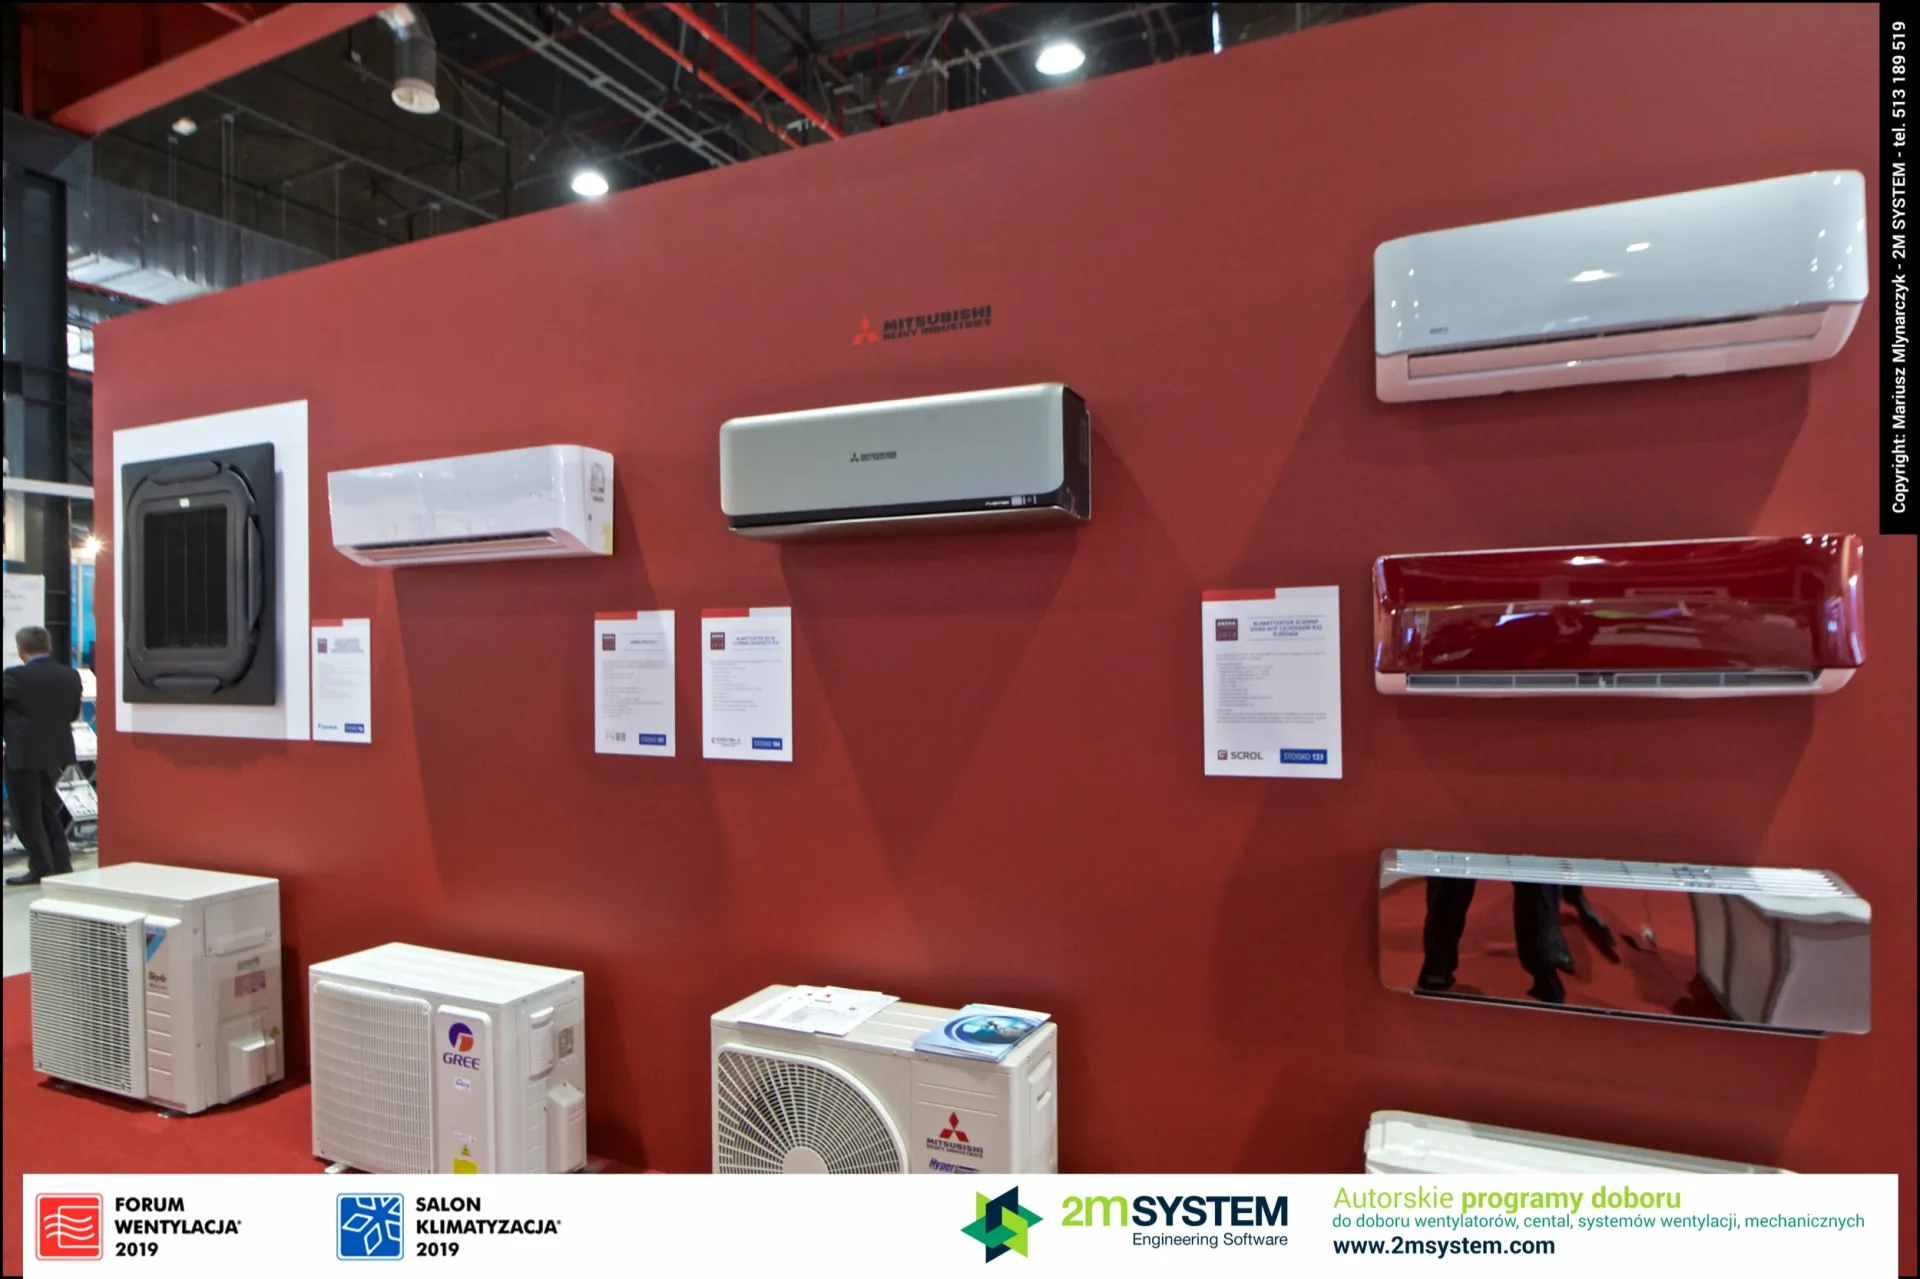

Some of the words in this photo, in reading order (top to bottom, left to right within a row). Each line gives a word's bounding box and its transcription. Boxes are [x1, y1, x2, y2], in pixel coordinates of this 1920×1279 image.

[883, 304, 992, 331] MITSUBISHI
[883, 330, 917, 340] HEAVY
[921, 318, 992, 336] INDUSTRIES
[1230, 751, 1263, 760] SCROL
[1283, 752, 1311, 761] STOISKO
[1312, 752, 1324, 761] 133
[443, 1051, 481, 1071] GREE
[926, 1137, 984, 1154] MITSUBISHI
